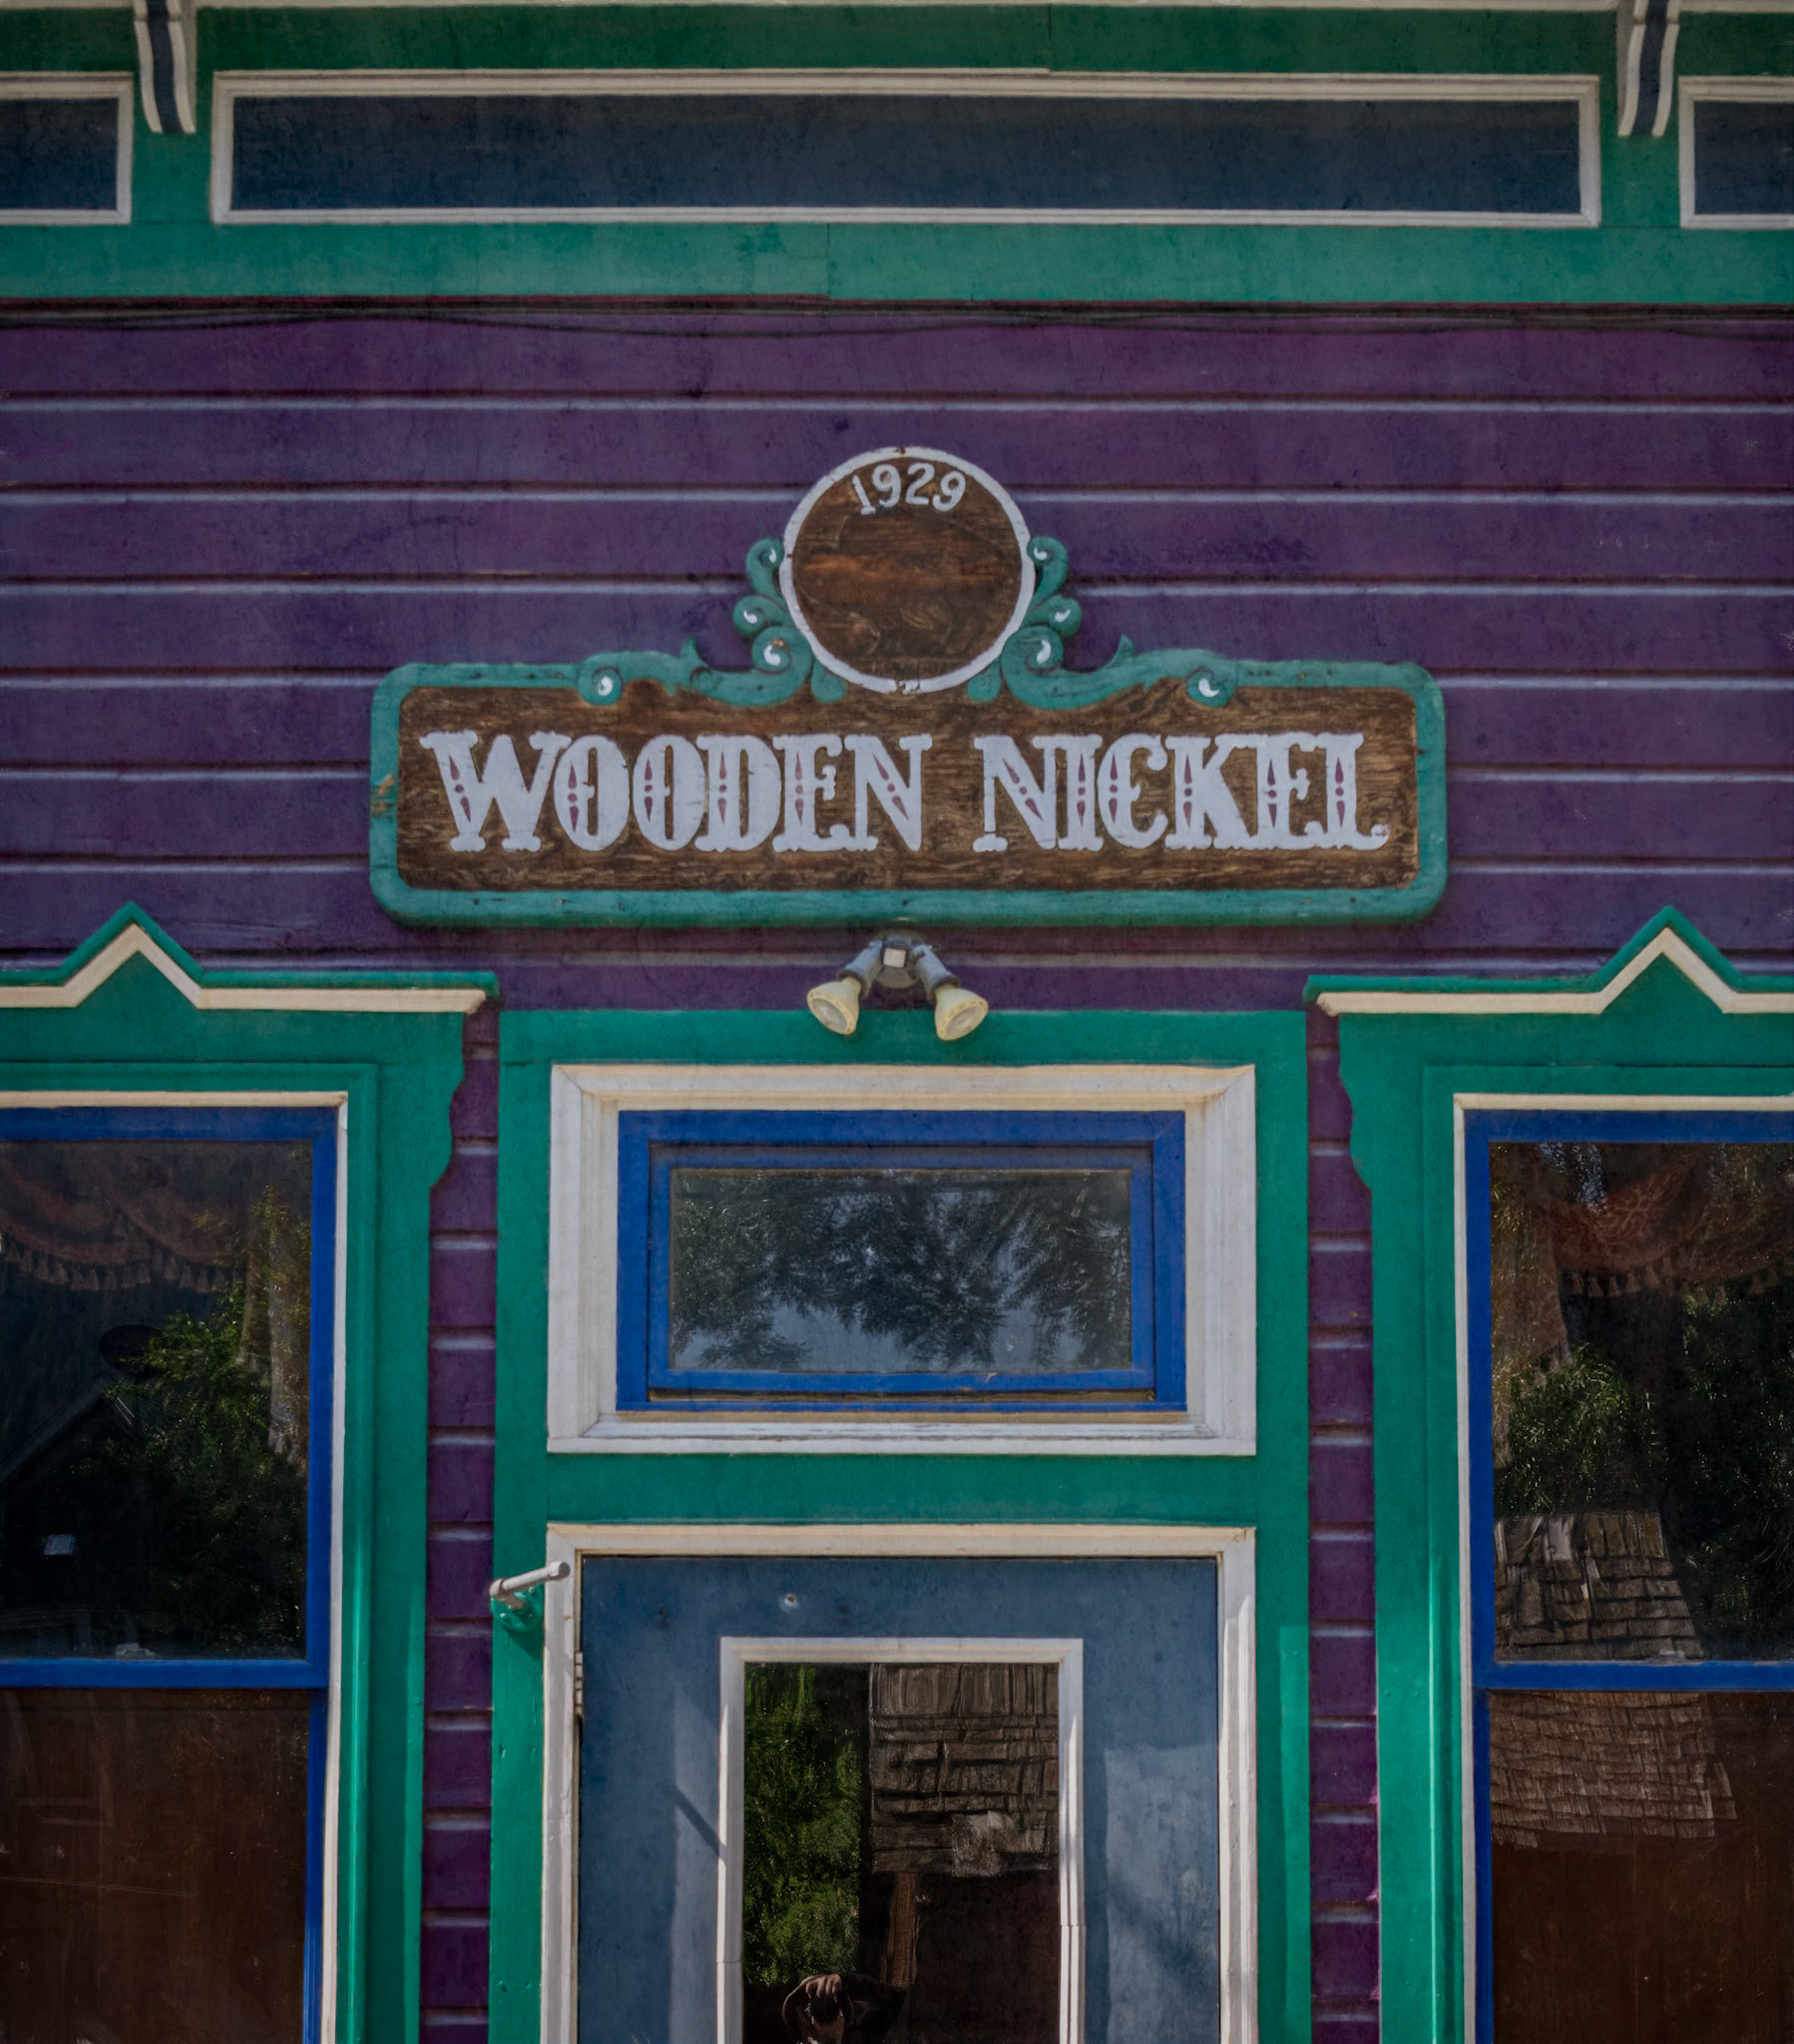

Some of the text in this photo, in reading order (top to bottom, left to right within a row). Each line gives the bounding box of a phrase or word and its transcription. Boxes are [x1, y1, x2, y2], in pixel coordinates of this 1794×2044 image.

[851, 462, 967, 516] 1929
[419, 729, 1391, 852] WOODEN NICKEL
